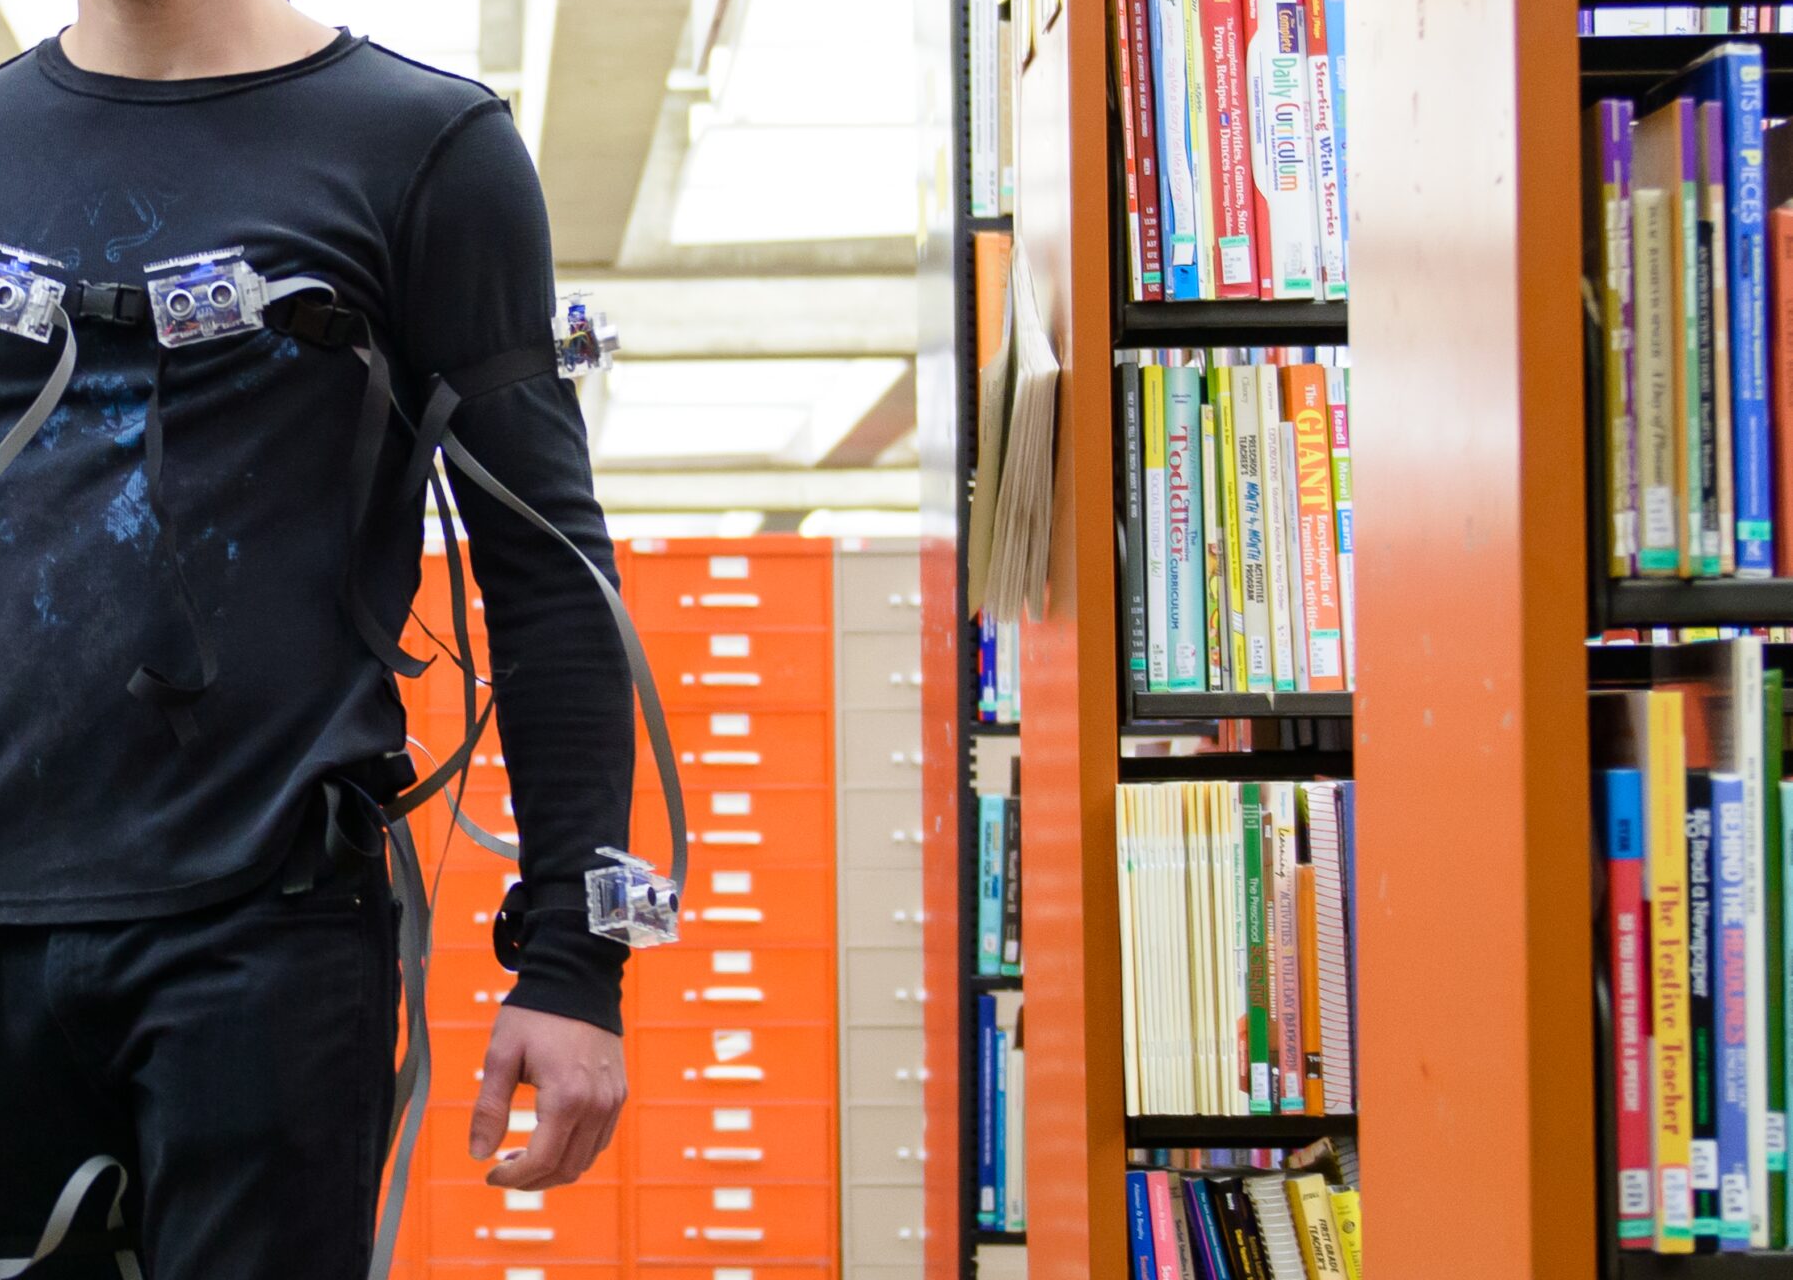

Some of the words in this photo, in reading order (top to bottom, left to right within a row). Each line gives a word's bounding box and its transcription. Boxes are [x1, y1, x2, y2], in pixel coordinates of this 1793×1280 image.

[1213, 26, 1225, 62] Props,
[1278, 10, 1293, 53] Complete
[1227, 32, 1238, 77] Complete
[1214, 65, 1228, 112] Recipes,
[1268, 58, 1297, 98] Daily
[1314, 62, 1329, 131] Starting
[1740, 65, 1761, 111] BITS
[1220, 129, 1231, 170] Dances
[1231, 108, 1243, 164] Activities,
[1275, 102, 1303, 191] Curriculum
[1743, 114, 1759, 144] and
[1319, 136, 1332, 177] With
[1234, 166, 1246, 208] Games,
[1739, 149, 1761, 224] PIECES
[1323, 182, 1336, 236] Stories
[1304, 384, 1317, 406] The
[1334, 410, 1347, 445] Read!
[1239, 436, 1249, 475] TEACHER'S
[1248, 435, 1258, 477] PRESCHOOL
[1296, 409, 1329, 511] GIANT
[1168, 426, 1189, 562] Toddler
[1339, 462, 1349, 499] Move!
[1301, 515, 1315, 576] Transition
[1316, 515, 1332, 590] Encyclopedia
[1170, 558, 1179, 630] CURRICULUM
[1245, 564, 1255, 601] PROGRAM
[1254, 563, 1264, 603] ACTIVITIES
[1322, 595, 1334, 607] of
[1274, 827, 1292, 879] Learning
[1692, 839, 1710, 882] Read
[1720, 802, 1744, 882] BEHIND
[1249, 878, 1260, 894] The
[1658, 881, 1681, 927] The
[1692, 886, 1706, 898] a
[1721, 885, 1743, 926] THE
[1249, 896, 1262, 943] Preschool
[1619, 934, 1635, 958] YOU
[1690, 901, 1711, 997] Newspaper
[1621, 963, 1638, 994] HAVE
[1659, 938, 1682, 1029] Festive
[1723, 928, 1746, 1045] HEADLINES
[1622, 999, 1639, 1013] TO
[1622, 1017, 1639, 1043] GIVE
[1623, 1047, 1640, 1056] A
[1661, 1041, 1685, 1135] Teacher
[1309, 1225, 1326, 1271] TEACHER'S
[1318, 1219, 1332, 1242] FIRST
[1325, 1243, 1340, 1273] GRADE
